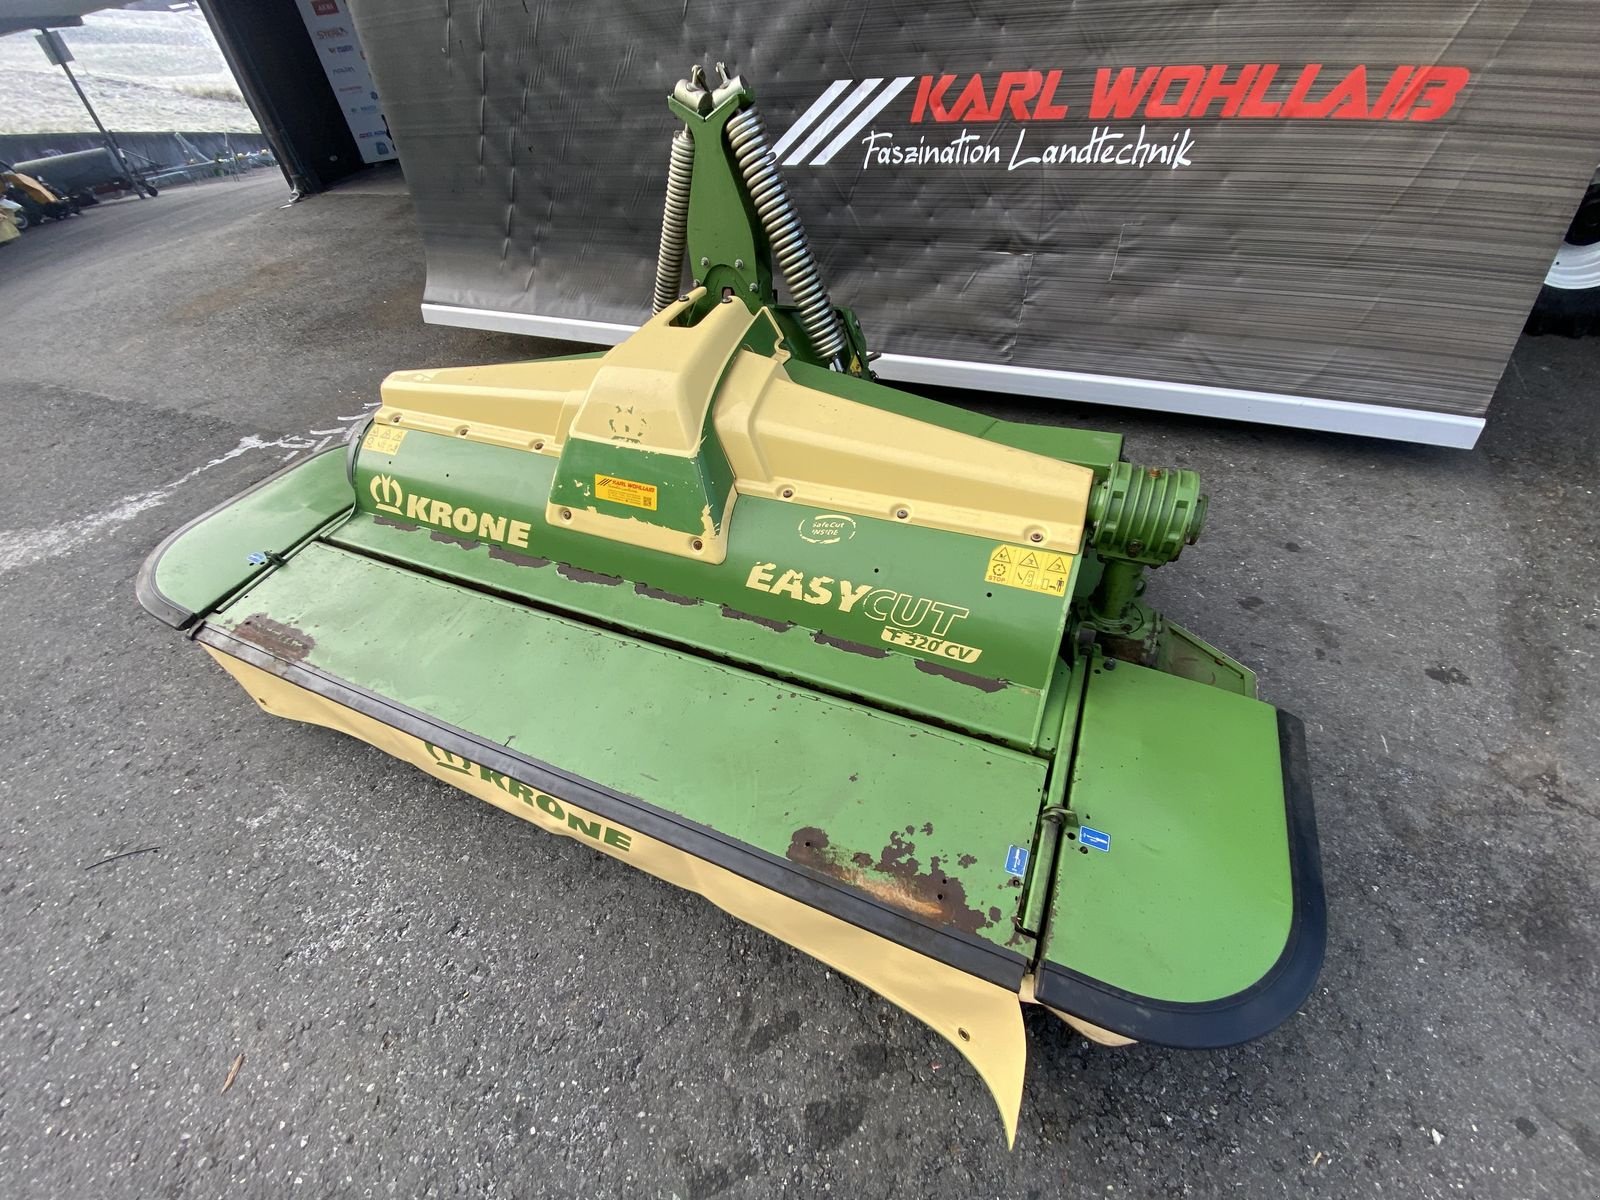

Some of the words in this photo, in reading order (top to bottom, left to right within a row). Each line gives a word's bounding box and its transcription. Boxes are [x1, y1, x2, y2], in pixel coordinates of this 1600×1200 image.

[910, 70, 1068, 123] KARL
[861, 127, 1001, 170] Faszination
[1007, 124, 1196, 170] Landtechnik
[406, 493, 532, 549] KRONE
[904, 631, 942, 652] 320
[944, 644, 974, 660] CV
[479, 765, 633, 852] KRONE
